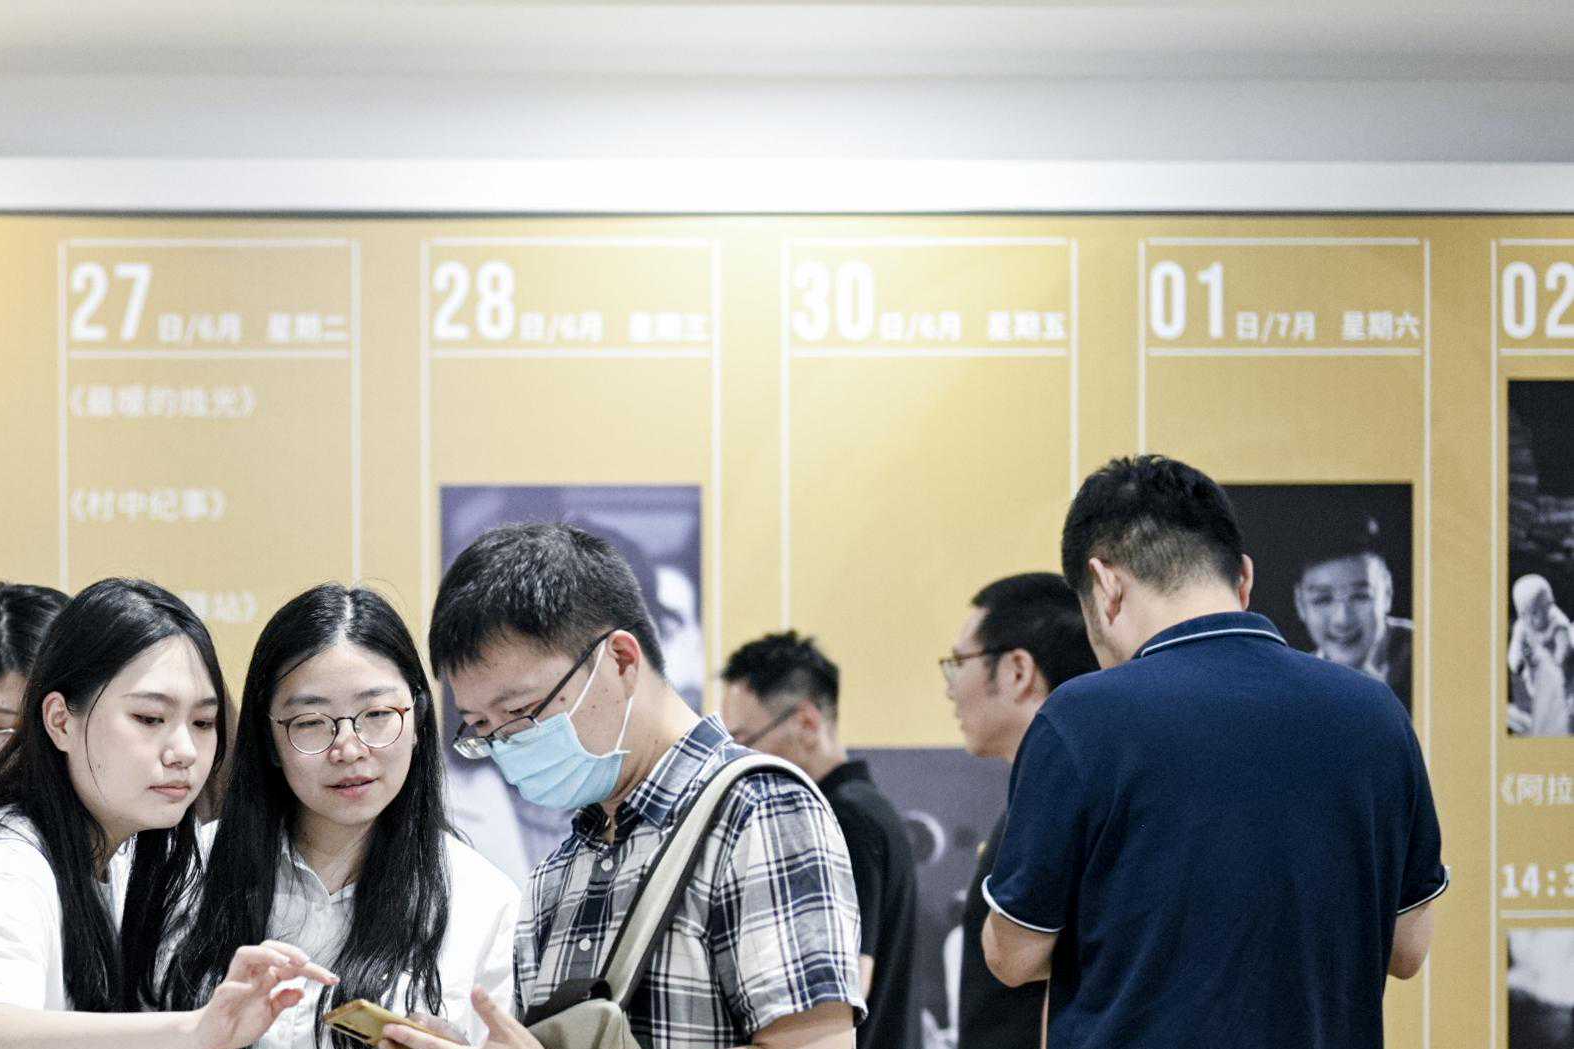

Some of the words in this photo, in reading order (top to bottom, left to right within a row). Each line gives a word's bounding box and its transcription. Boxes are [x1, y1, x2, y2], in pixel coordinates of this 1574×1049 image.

[1342, 310, 1421, 341] 星期六
[1502, 261, 1574, 339] 02
